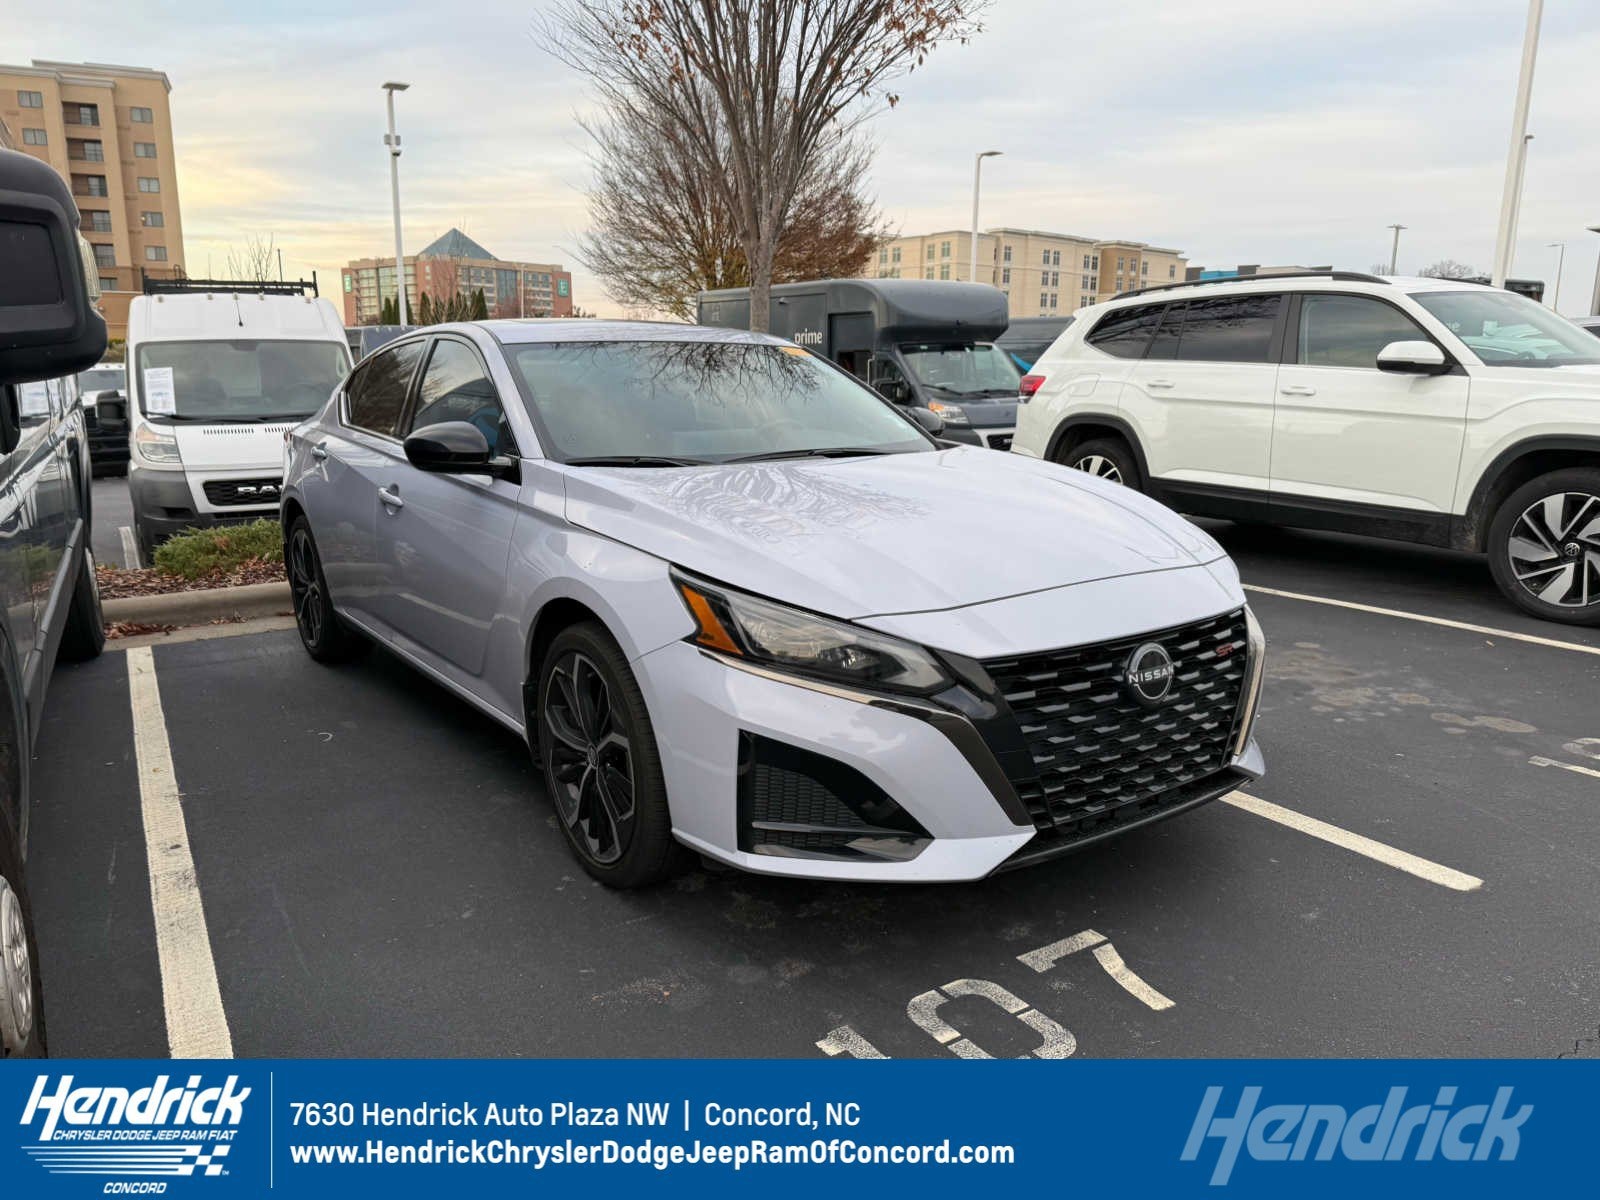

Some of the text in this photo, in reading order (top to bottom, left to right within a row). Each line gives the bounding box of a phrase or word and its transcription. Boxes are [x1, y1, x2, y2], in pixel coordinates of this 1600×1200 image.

[794, 328, 823, 345] prime
[237, 485, 283, 496] RA
[1215, 643, 1234, 657] SR
[1128, 663, 1174, 684] NISSAN
